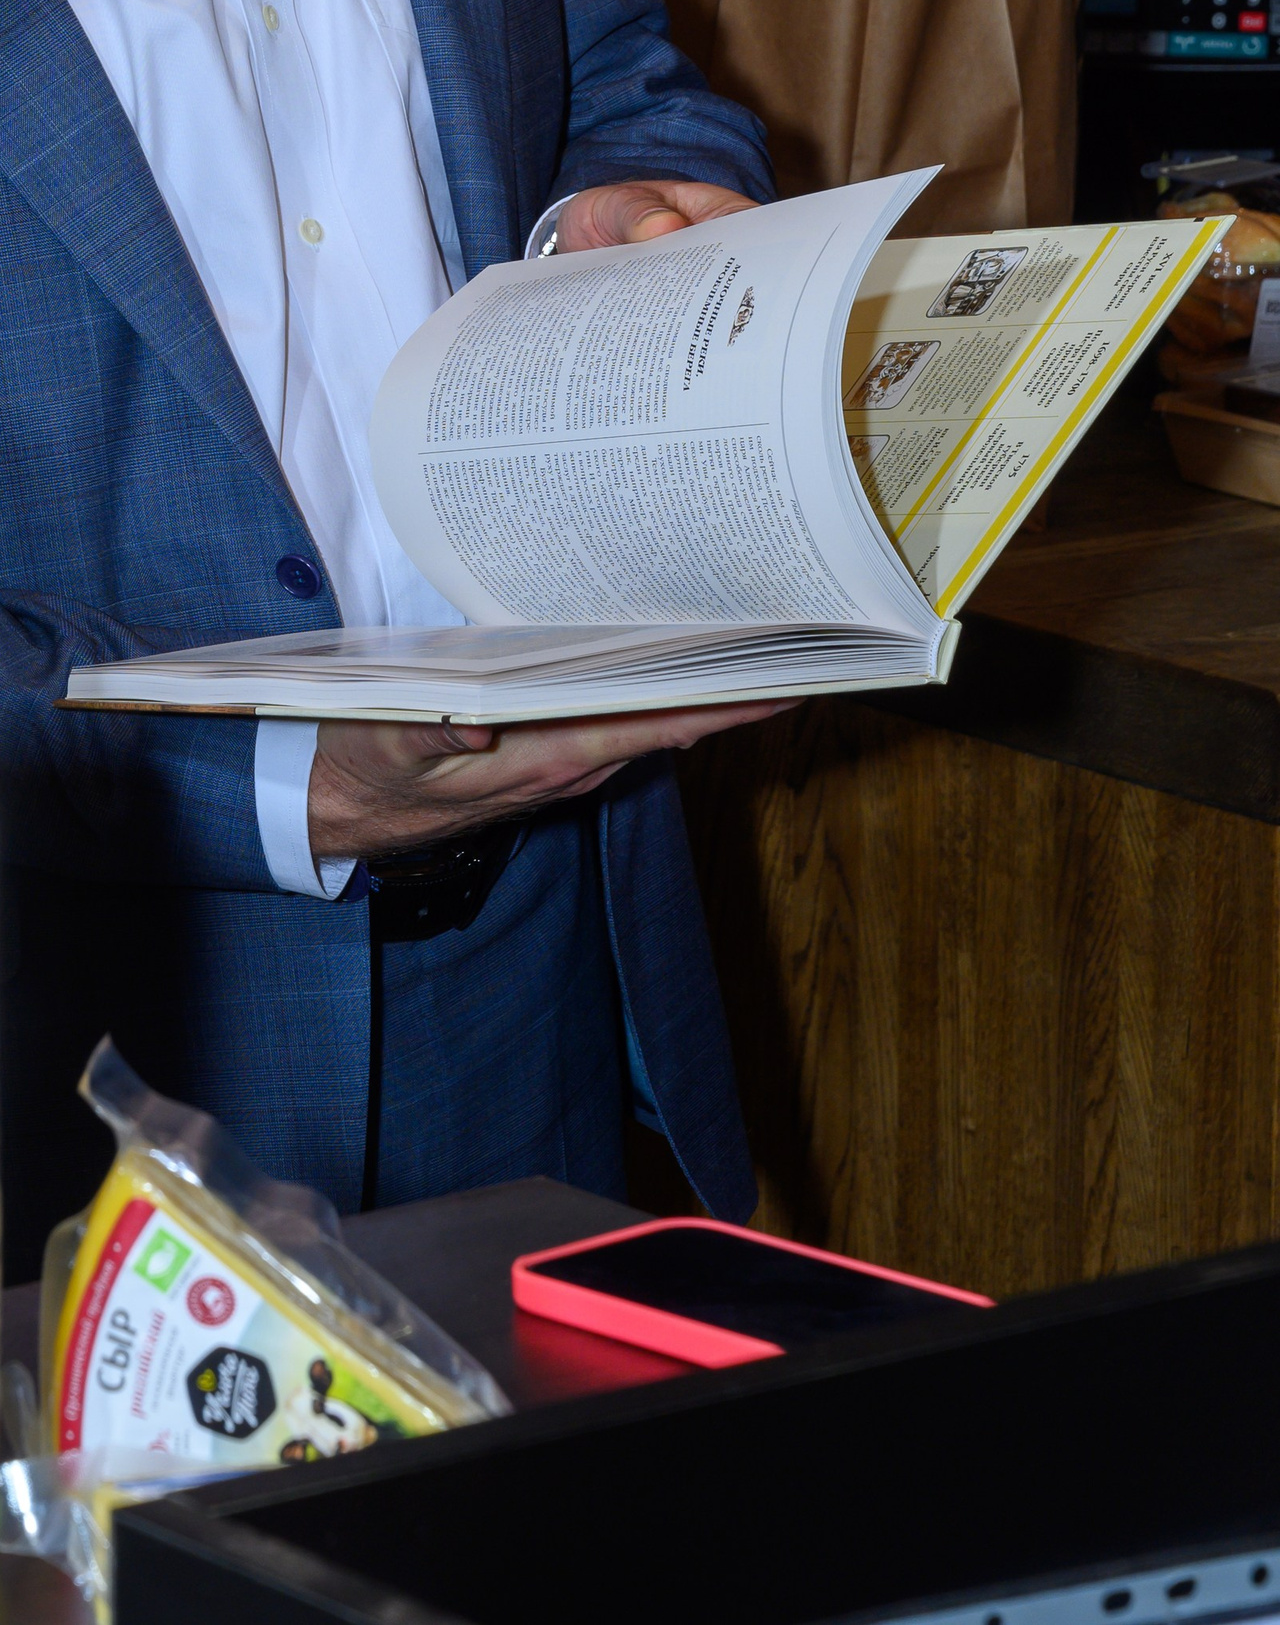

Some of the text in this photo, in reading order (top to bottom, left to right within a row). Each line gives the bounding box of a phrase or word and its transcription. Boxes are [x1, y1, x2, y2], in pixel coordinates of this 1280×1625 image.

[1041, 240, 1063, 260] сыры
[1101, 235, 1163, 312] известны свежие
[1111, 237, 1169, 309] На Руси хорошо
[1111, 261, 1136, 286] сыры
[1137, 251, 1174, 293] XVI век
[1032, 252, 1076, 303] древнерусской
[666, 320, 683, 359] команда
[682, 256, 737, 391] ПРОБЛЕМНЫЕ БЕРЕГА
[694, 263, 742, 377] МОЛОЧНЫЕ РЕКИ,
[1068, 331, 1095, 359] Петра
[651, 374, 662, 413] сильнее
[1019, 346, 1059, 392] сыроделы
[1023, 341, 1072, 398] голландские
[1033, 343, 1078, 395] приезжают
[1033, 371, 1066, 406] Россию
[1040, 329, 1104, 408] По приглашению
[906, 427, 944, 471] Лотошино
[934, 422, 1007, 511] сыродельный завод
[948, 429, 1010, 504] первый частный
[967, 443, 1007, 489] возникает
[975, 444, 1015, 488] губернии
[981, 447, 1021, 491] Тверской
[1004, 453, 1031, 478] 1795
[741, 464, 787, 567] Алексея Михайловича,
[747, 455, 792, 561] подход. Почти двести
[757, 465, 803, 563] революционным был
[764, 448, 779, 483] Сейчас
[774, 489, 786, 508] нам
[781, 513, 802, 546] трудно
[97, 1308, 138, 1394] СЫР
